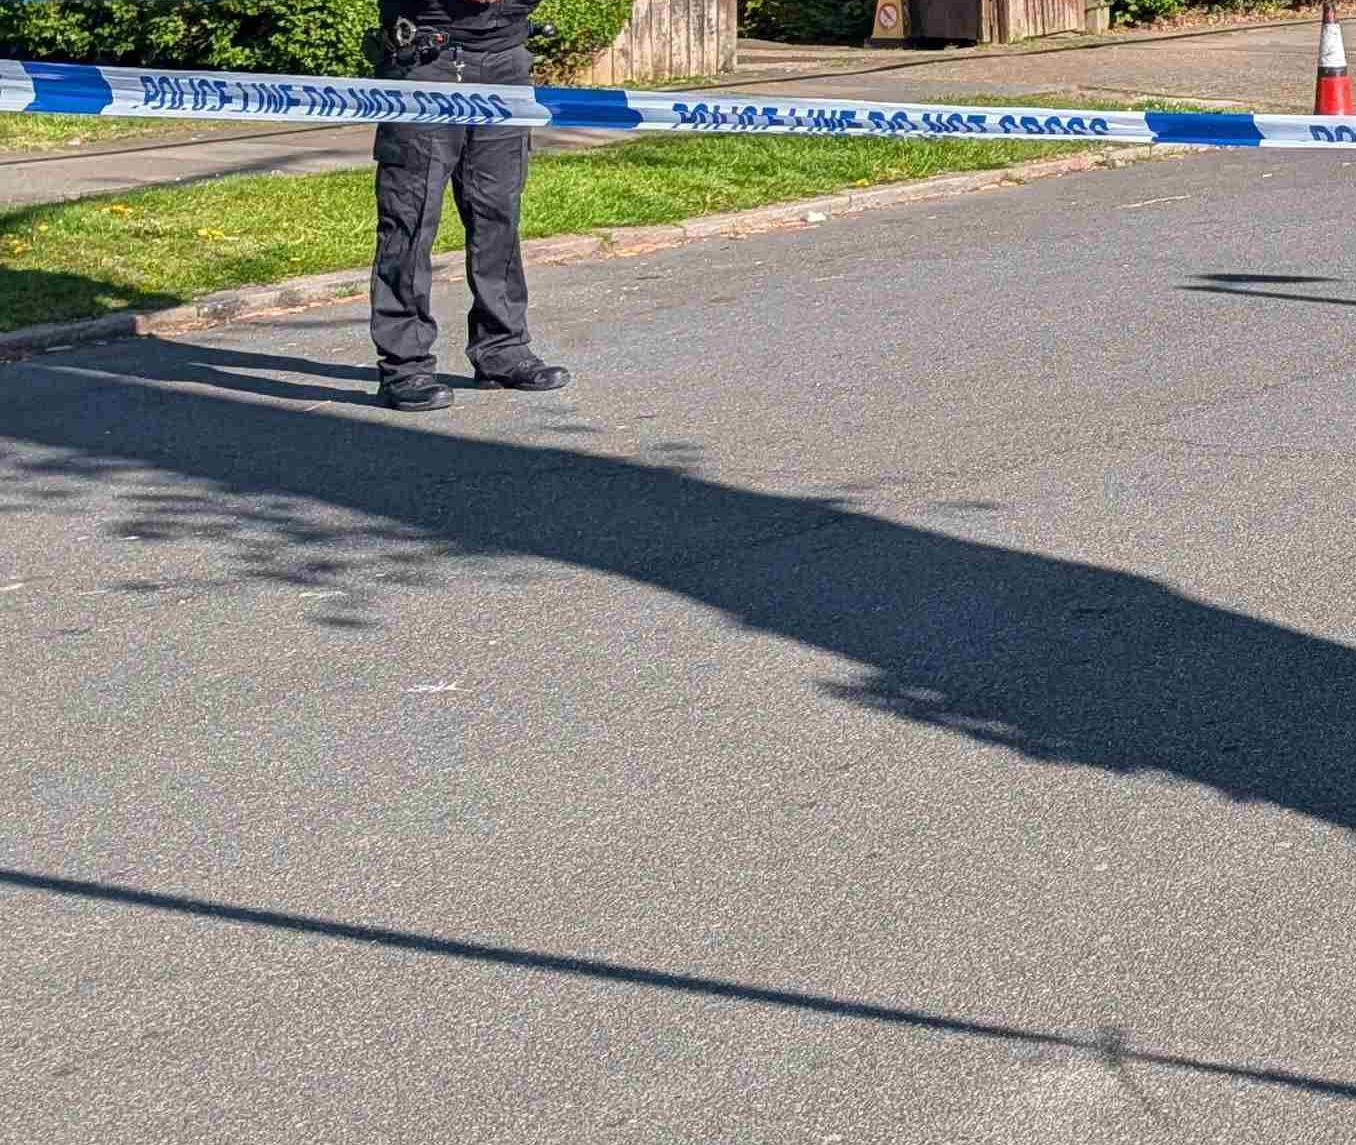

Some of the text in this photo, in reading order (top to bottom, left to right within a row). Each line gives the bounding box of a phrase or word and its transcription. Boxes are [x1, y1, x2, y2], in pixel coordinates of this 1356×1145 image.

[138, 75, 232, 112] POLICE
[230, 82, 300, 114] LINE
[347, 88, 406, 119] NOT
[411, 90, 512, 124] CROSS
